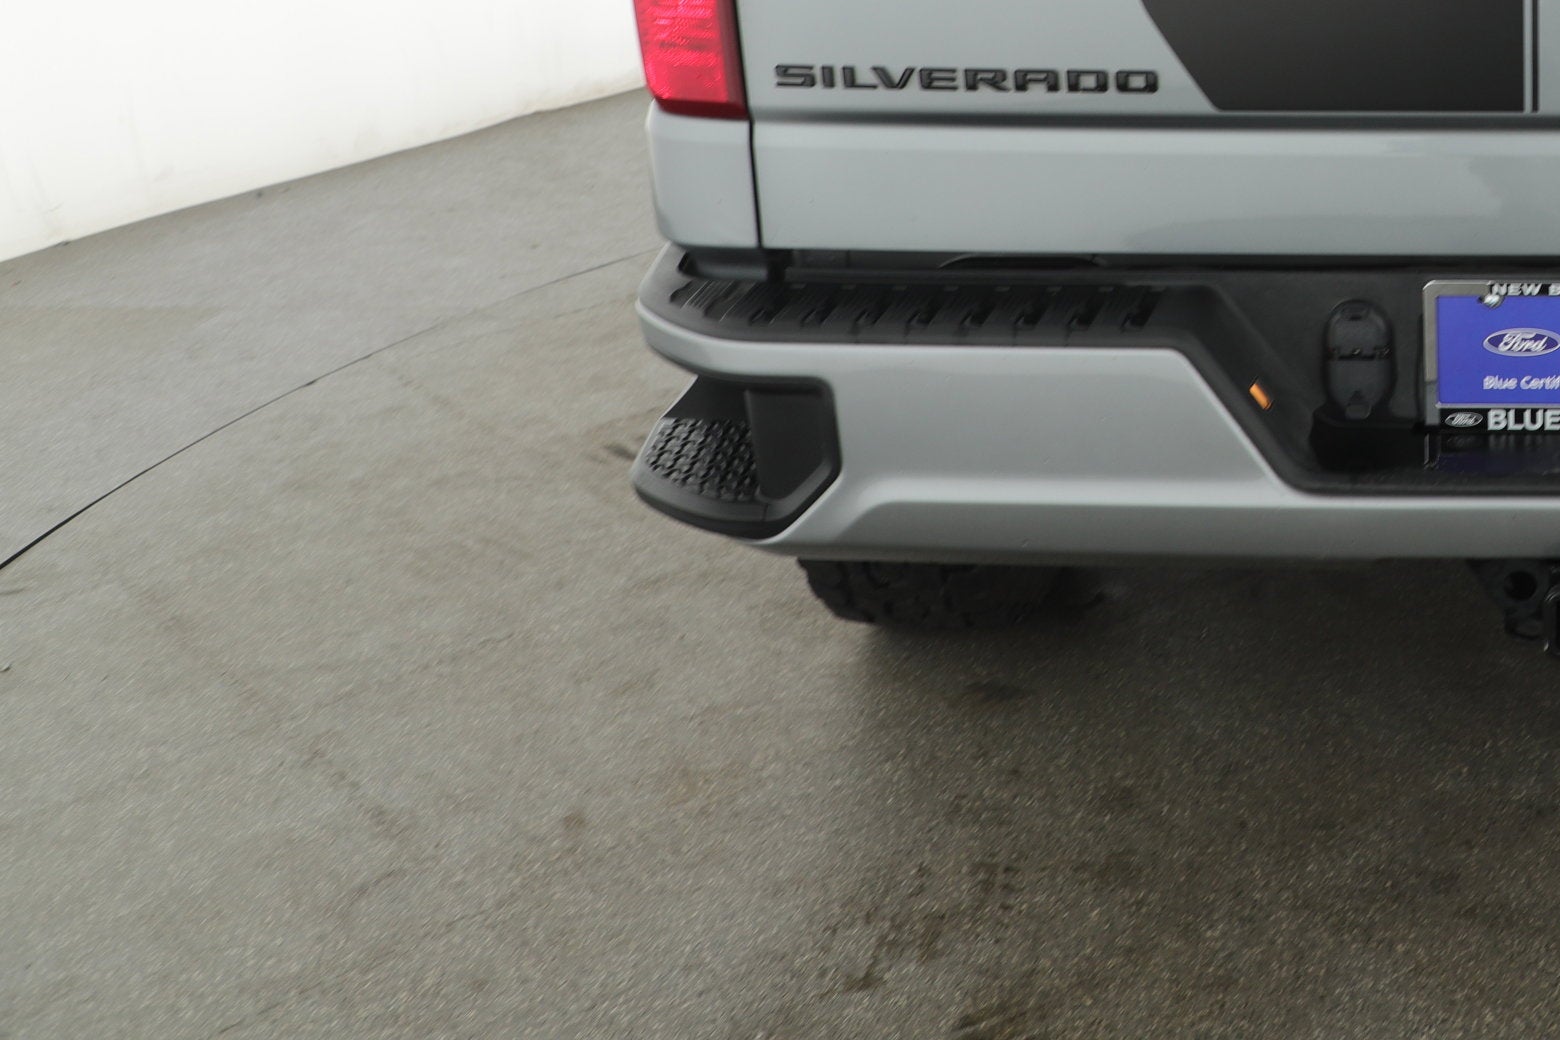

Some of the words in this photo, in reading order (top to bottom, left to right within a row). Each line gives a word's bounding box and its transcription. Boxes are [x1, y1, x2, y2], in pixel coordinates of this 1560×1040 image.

[775, 64, 1159, 94] SILVERADO
[1491, 282, 1542, 297] NEW
[1497, 331, 1549, 353] Ford
[1483, 375, 1517, 390] Blue
